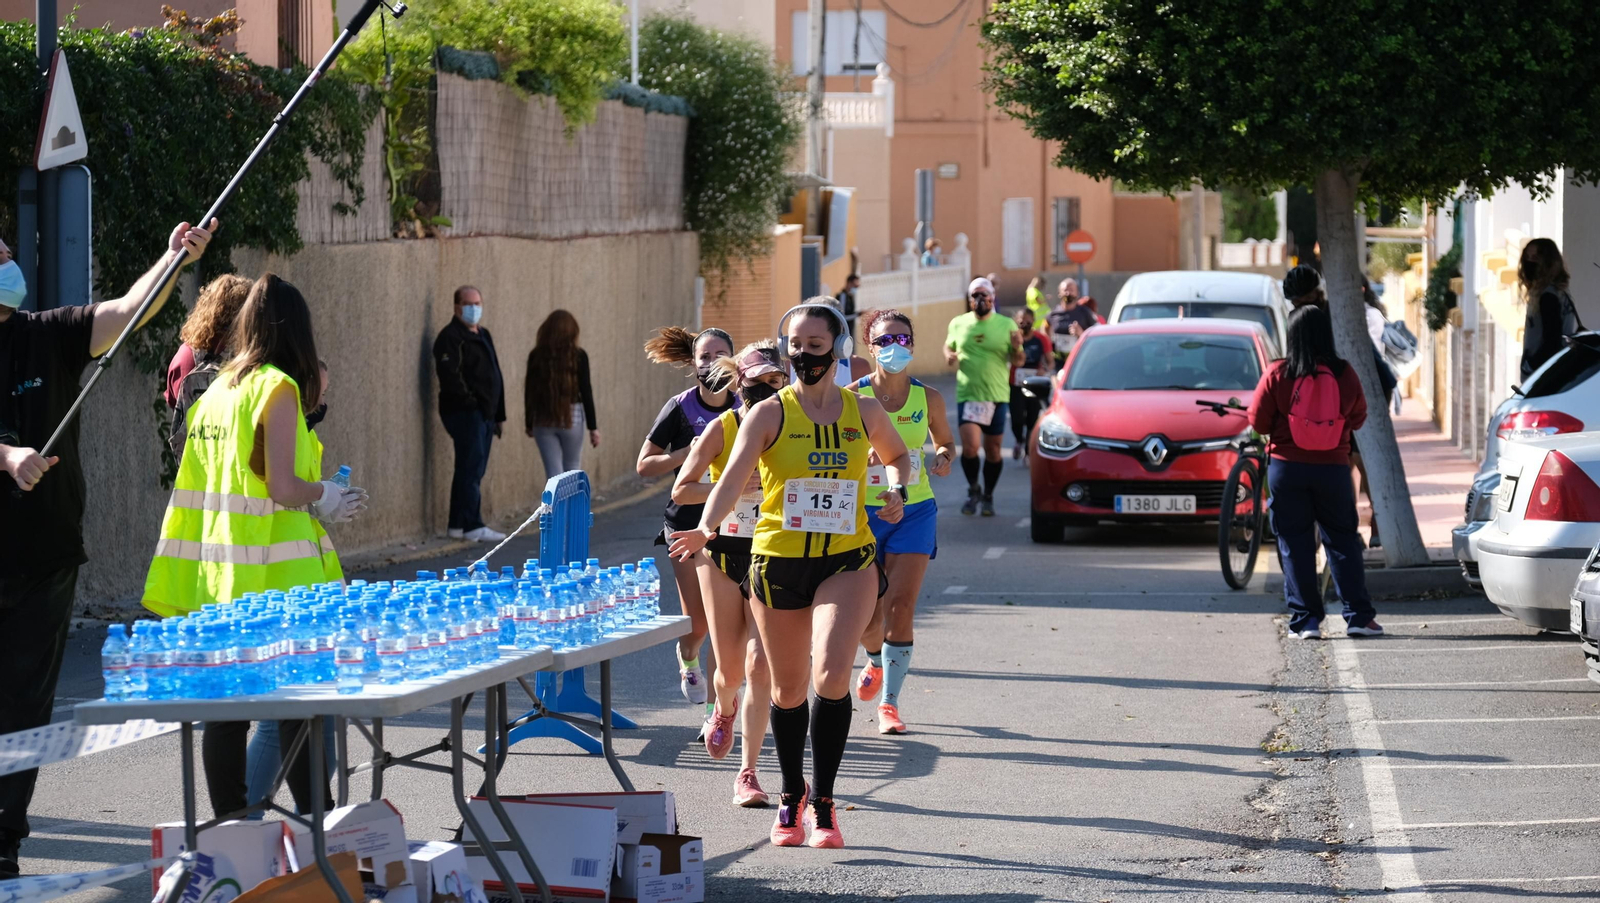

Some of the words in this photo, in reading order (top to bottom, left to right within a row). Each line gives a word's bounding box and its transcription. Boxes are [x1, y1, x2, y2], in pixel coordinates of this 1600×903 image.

[808, 452, 848, 465] OTIS
[810, 494, 832, 509] 15
[1127, 498, 1160, 511] 1380
[1166, 498, 1192, 511] JLG
[803, 510, 830, 518] VIRGINIA
